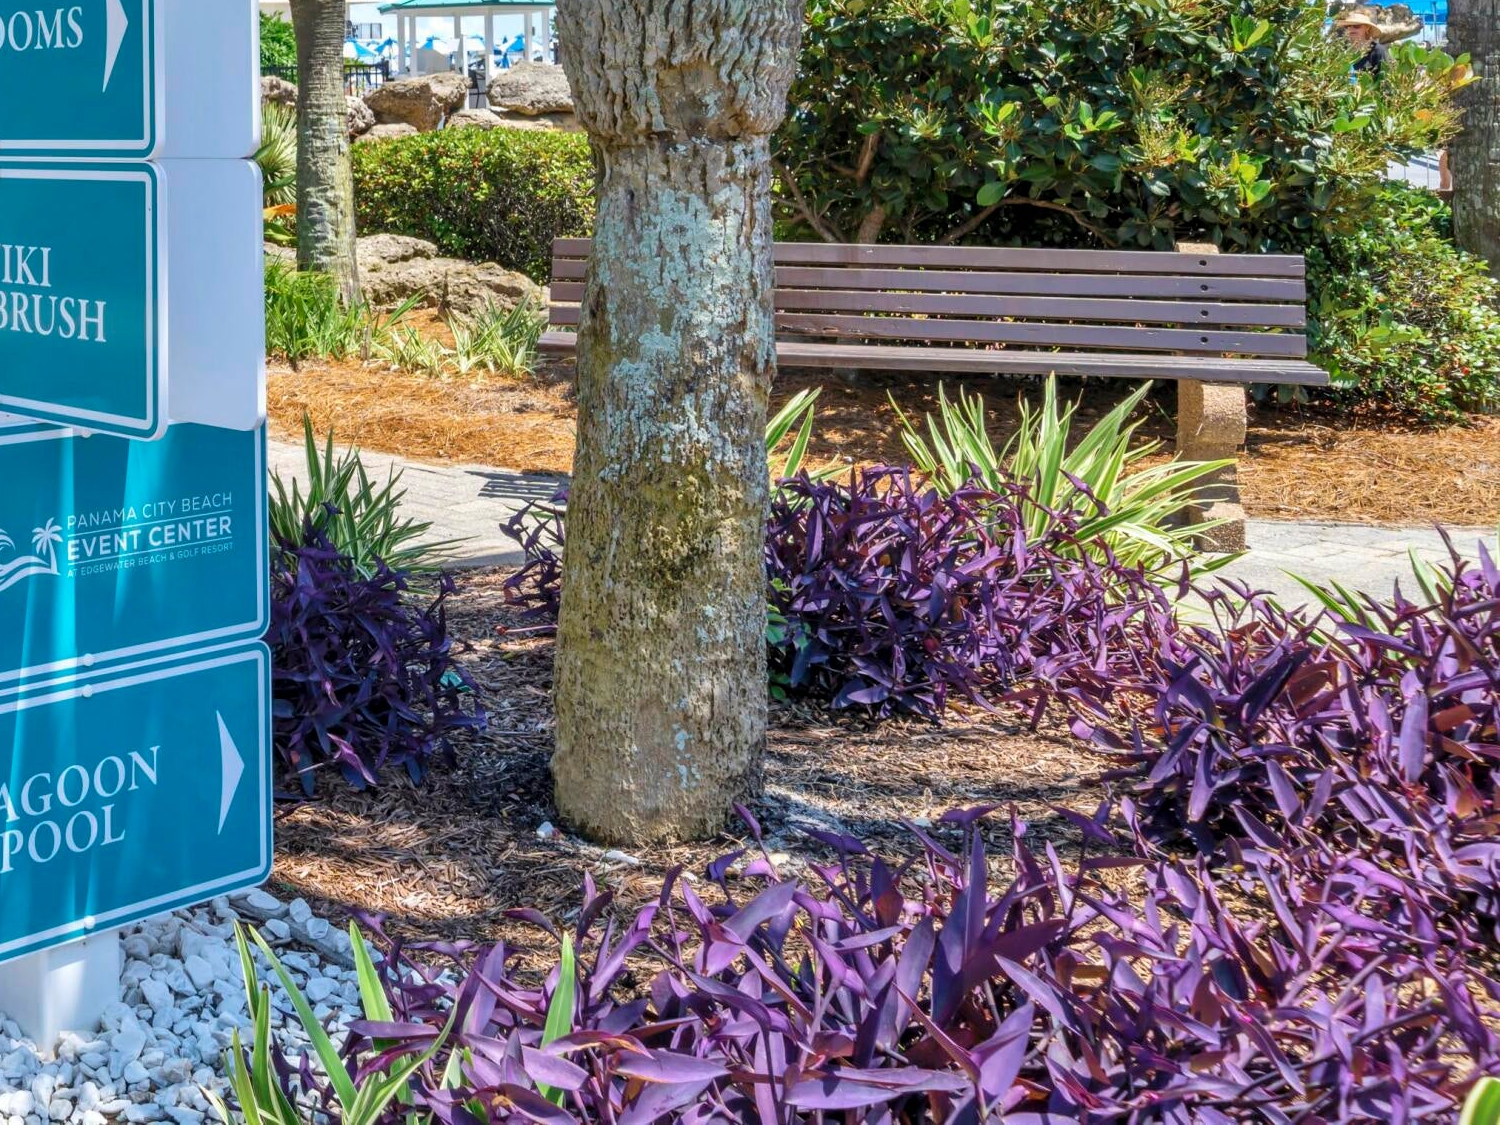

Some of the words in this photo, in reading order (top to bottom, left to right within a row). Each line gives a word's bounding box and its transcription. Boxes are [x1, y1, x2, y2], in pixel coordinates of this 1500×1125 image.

[67, 506, 137, 530] PANAMA
[142, 499, 176, 519] CITY
[182, 491, 233, 512] BEACH
[67, 529, 141, 561] EVENT
[148, 515, 232, 546] CENTER
[67, 568, 78, 578] AT
[80, 559, 135, 577] EDGEWATER
[138, 552, 169, 566] BEACH
[169, 551, 176, 562] &
[177, 547, 199, 560] GOLF
[201, 542, 233, 555] RESORT
